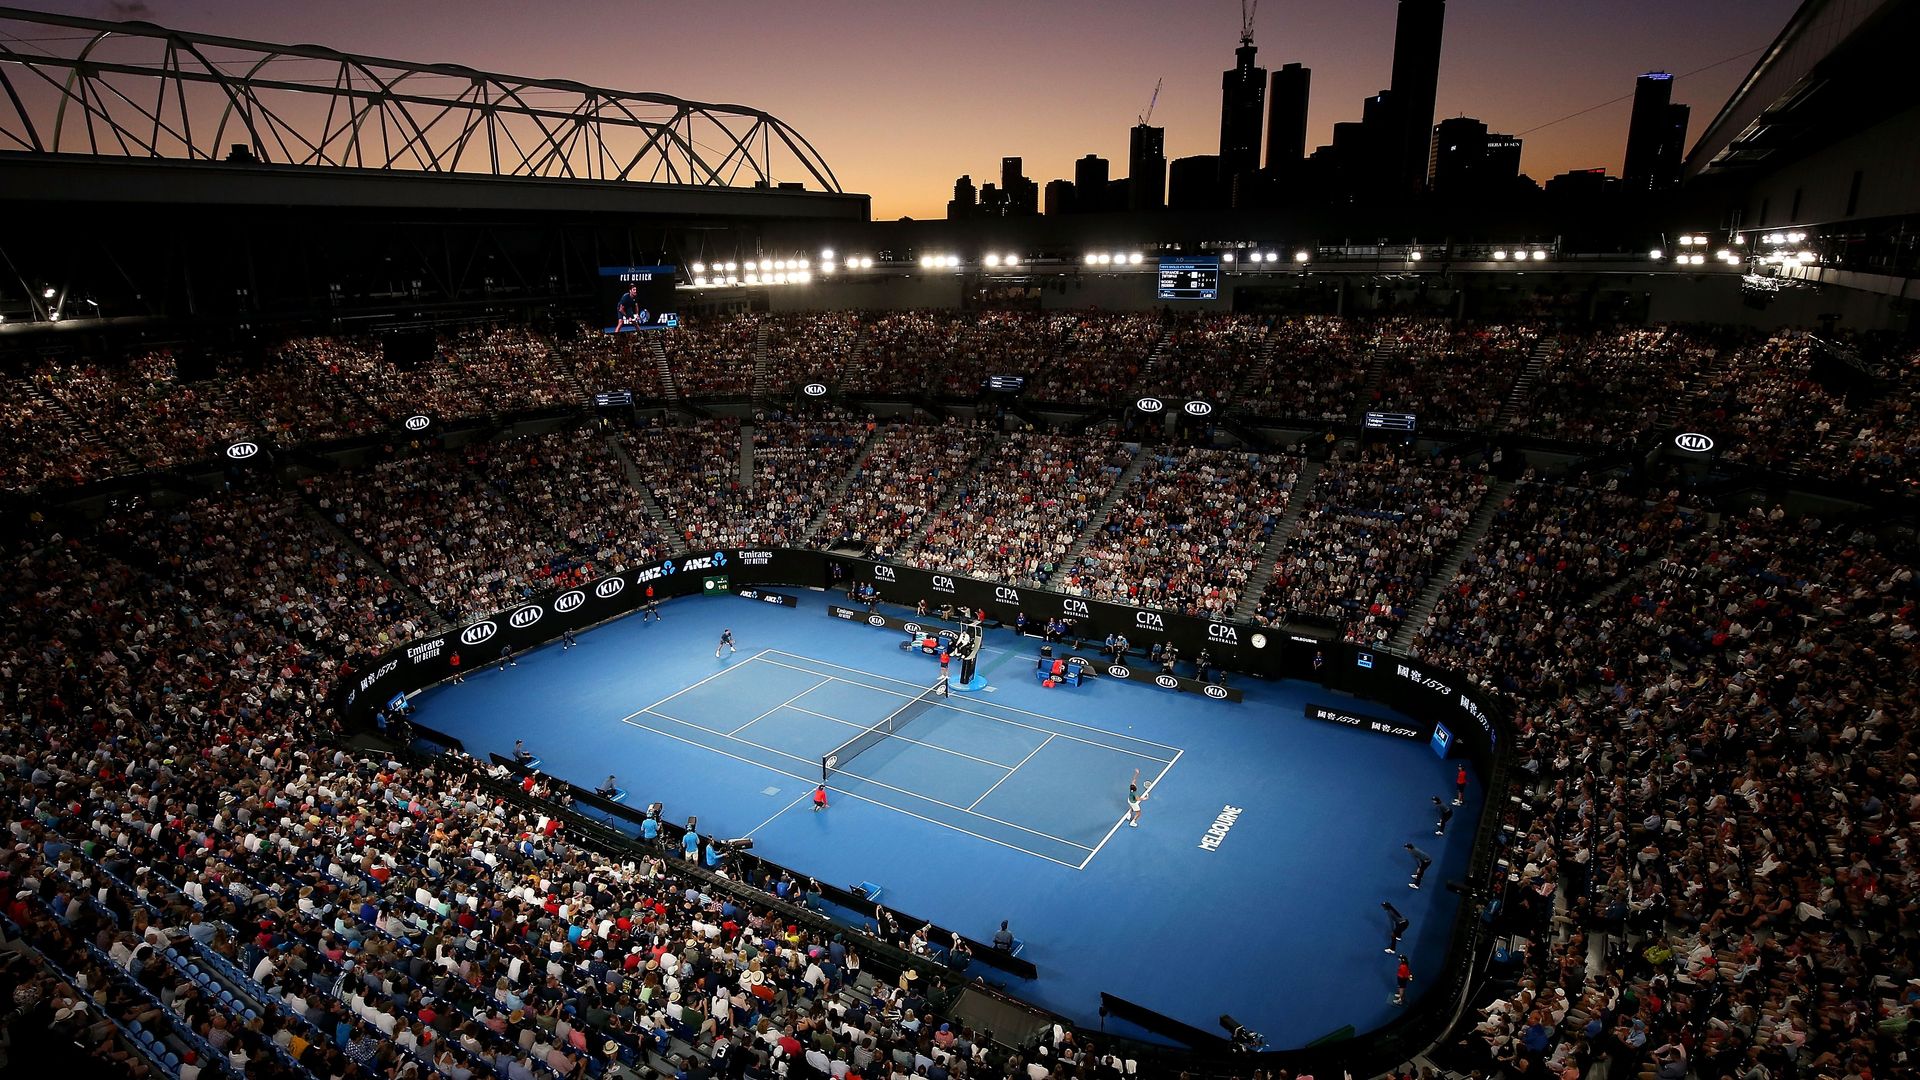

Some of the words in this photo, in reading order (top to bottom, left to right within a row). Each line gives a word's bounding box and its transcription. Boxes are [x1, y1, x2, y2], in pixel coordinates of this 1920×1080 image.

[1682, 436, 1706, 448] KIA
[738, 551, 772, 559] Emirates
[683, 557, 712, 572] ANZ
[875, 565, 895, 578] CPA
[637, 566, 662, 584] ANZ
[601, 581, 620, 595] KIA
[933, 576, 954, 589] CPA
[764, 595, 777, 603] ANZ
[995, 586, 1019, 600] CPA
[560, 594, 580, 609] KIA
[1064, 599, 1089, 613] CPA
[516, 609, 538, 625] KIA
[1064, 610, 1089, 618] AUSTRALIA
[1136, 611, 1163, 626] CPA
[467, 624, 491, 641] KIA
[1136, 623, 1164, 632] AUSTRALIA
[1208, 624, 1237, 640] CPA
[1208, 636, 1238, 645] AUSTRALIA
[407, 638, 444, 658] Emirates
[1197, 805, 1242, 851] MELBOURNE
